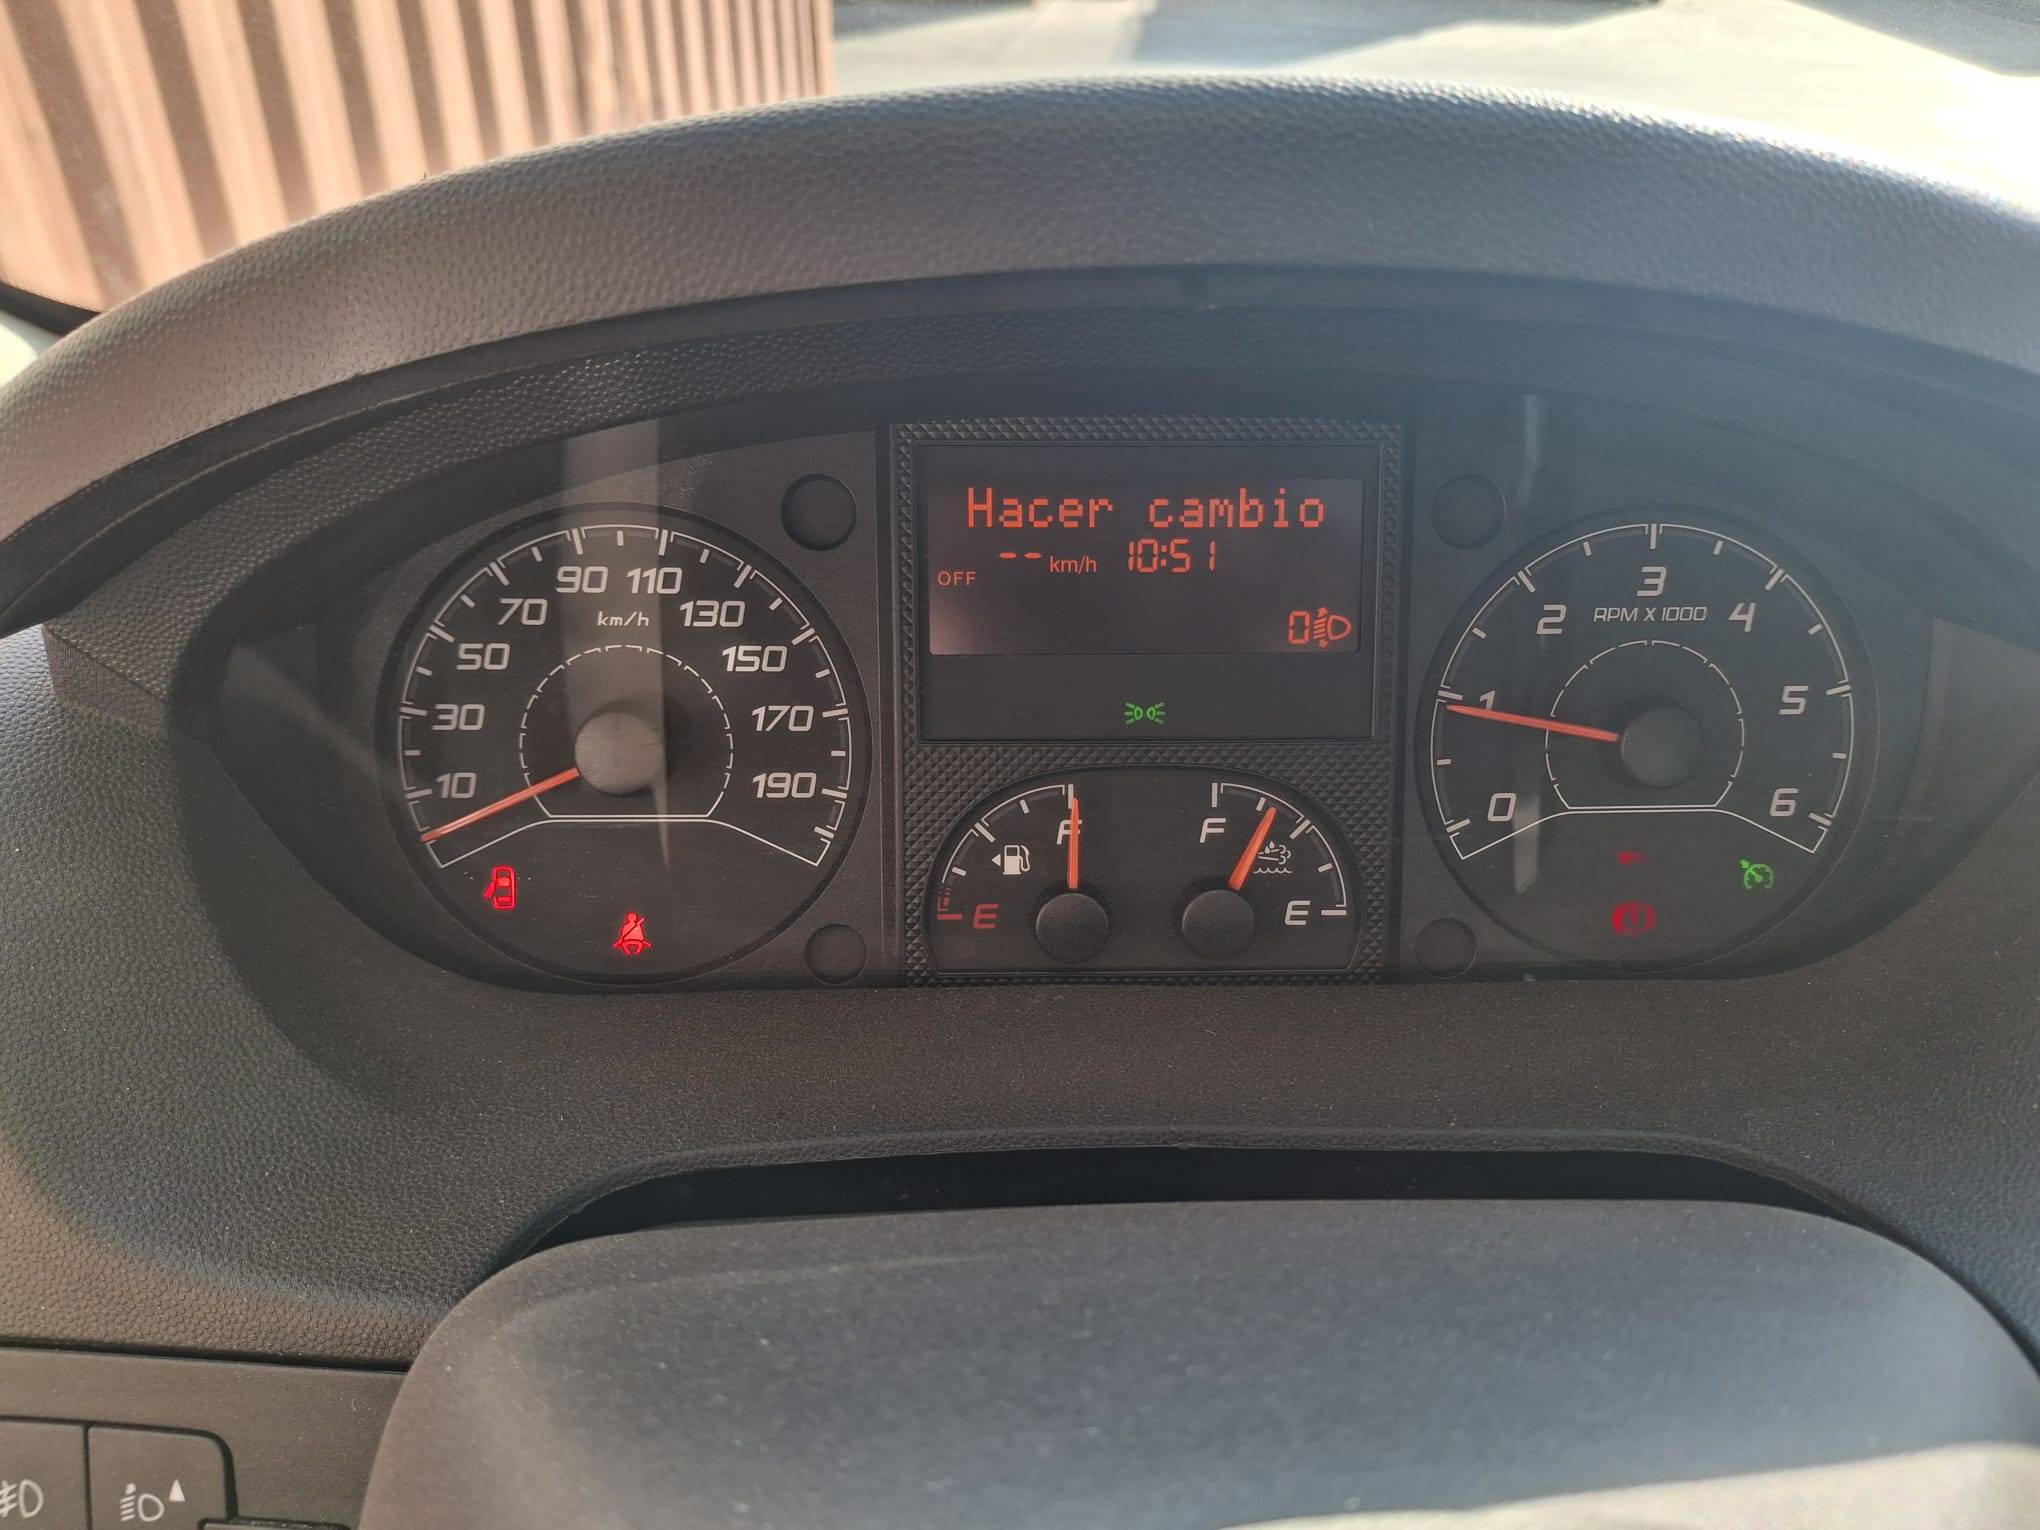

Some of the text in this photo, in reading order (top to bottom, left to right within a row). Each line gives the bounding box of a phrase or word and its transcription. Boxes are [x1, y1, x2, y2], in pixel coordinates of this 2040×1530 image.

[967, 487, 1326, 528] Hacer cambio
[1049, 555, 1097, 575] km/h
[1127, 538, 1216, 573] 10:51
[556, 565, 608, 594] 90
[627, 567, 683, 594] 110
[937, 570, 977, 586] OFF
[1636, 566, 1667, 597] 3
[497, 598, 548, 626] 70
[597, 610, 650, 627] km/h
[679, 600, 746, 627] 130
[1536, 604, 1567, 635] 2
[1593, 606, 1708, 622] RPM X 1000
[1728, 602, 1757, 633] 4
[1288, 610, 1310, 644] 0
[456, 643, 510, 671] 50
[722, 645, 788, 672] 150
[1479, 690, 1496, 713] 1
[1779, 685, 1809, 716] 5
[432, 703, 486, 731] 30
[751, 705, 814, 732] 170
[436, 772, 477, 799] 10
[752, 772, 817, 799] 190
[1487, 792, 1517, 822] 0
[1769, 787, 1799, 817] 6
[1056, 819, 1083, 845] F
[1199, 817, 1227, 844] F
[972, 903, 1000, 930] E
[1284, 900, 1311, 926] E
